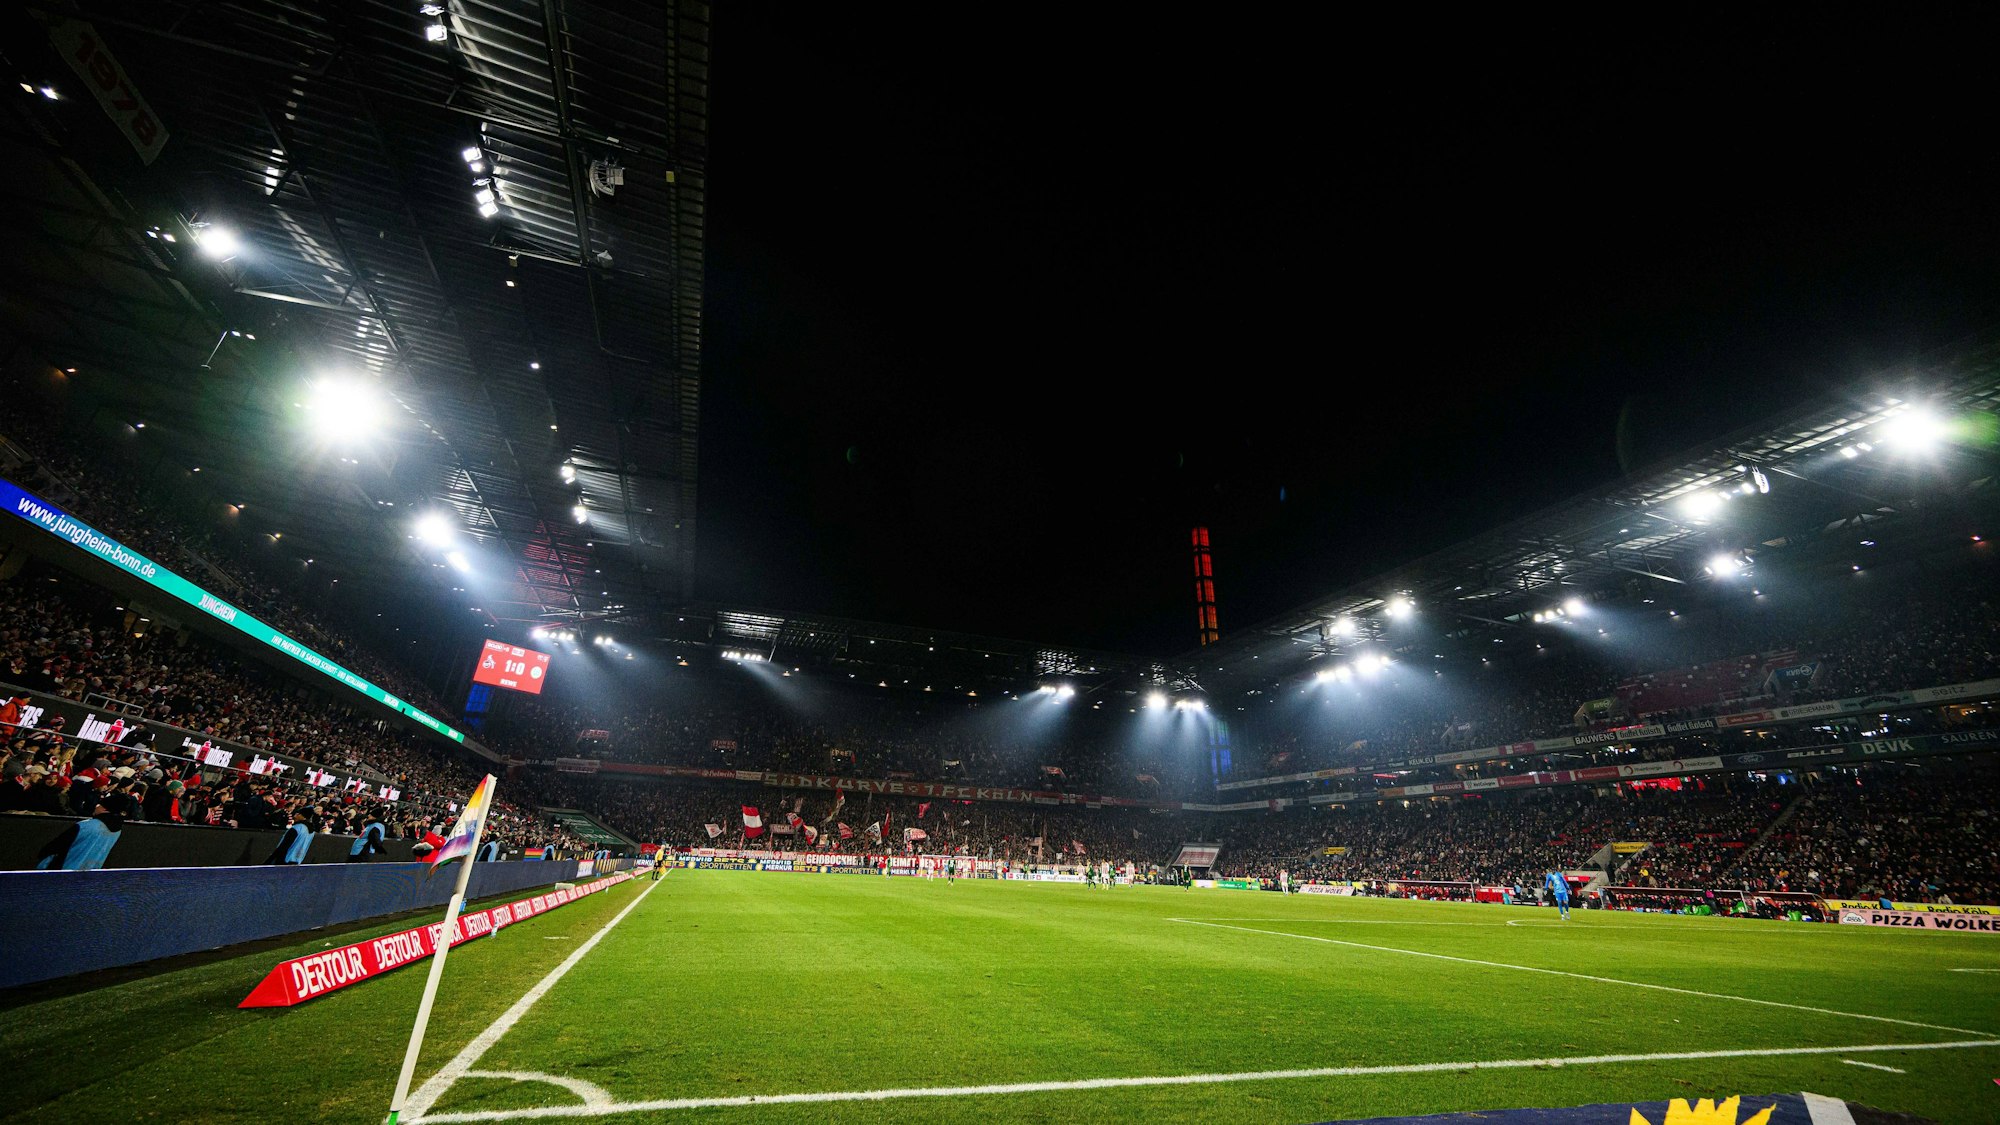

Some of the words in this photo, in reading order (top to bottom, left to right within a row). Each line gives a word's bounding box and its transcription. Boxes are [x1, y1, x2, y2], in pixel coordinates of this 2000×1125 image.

[75, 31, 158, 148] 1978
[17, 497, 156, 578] www.jungheim-bonn.de
[198, 593, 238, 622] JUNGHEIM
[505, 659, 525, 676] 1:0
[1931, 686, 1968, 697] seitz
[1789, 703, 1835, 714] GRIESEMANN
[1667, 722, 1688, 732] Gaffel
[1575, 732, 1615, 745] BAUWENS
[1941, 730, 1998, 744] SAUREN
[1860, 739, 1915, 755] DEVK
[699, 862, 752, 870] SPORTWETTEN
[463, 911, 493, 938] DERTOUR
[1872, 914, 1926, 928] PIZZA
[1934, 917, 2000, 932] WOLKE
[373, 930, 425, 970] DERTOUR
[291, 946, 368, 999] DERTOUR
